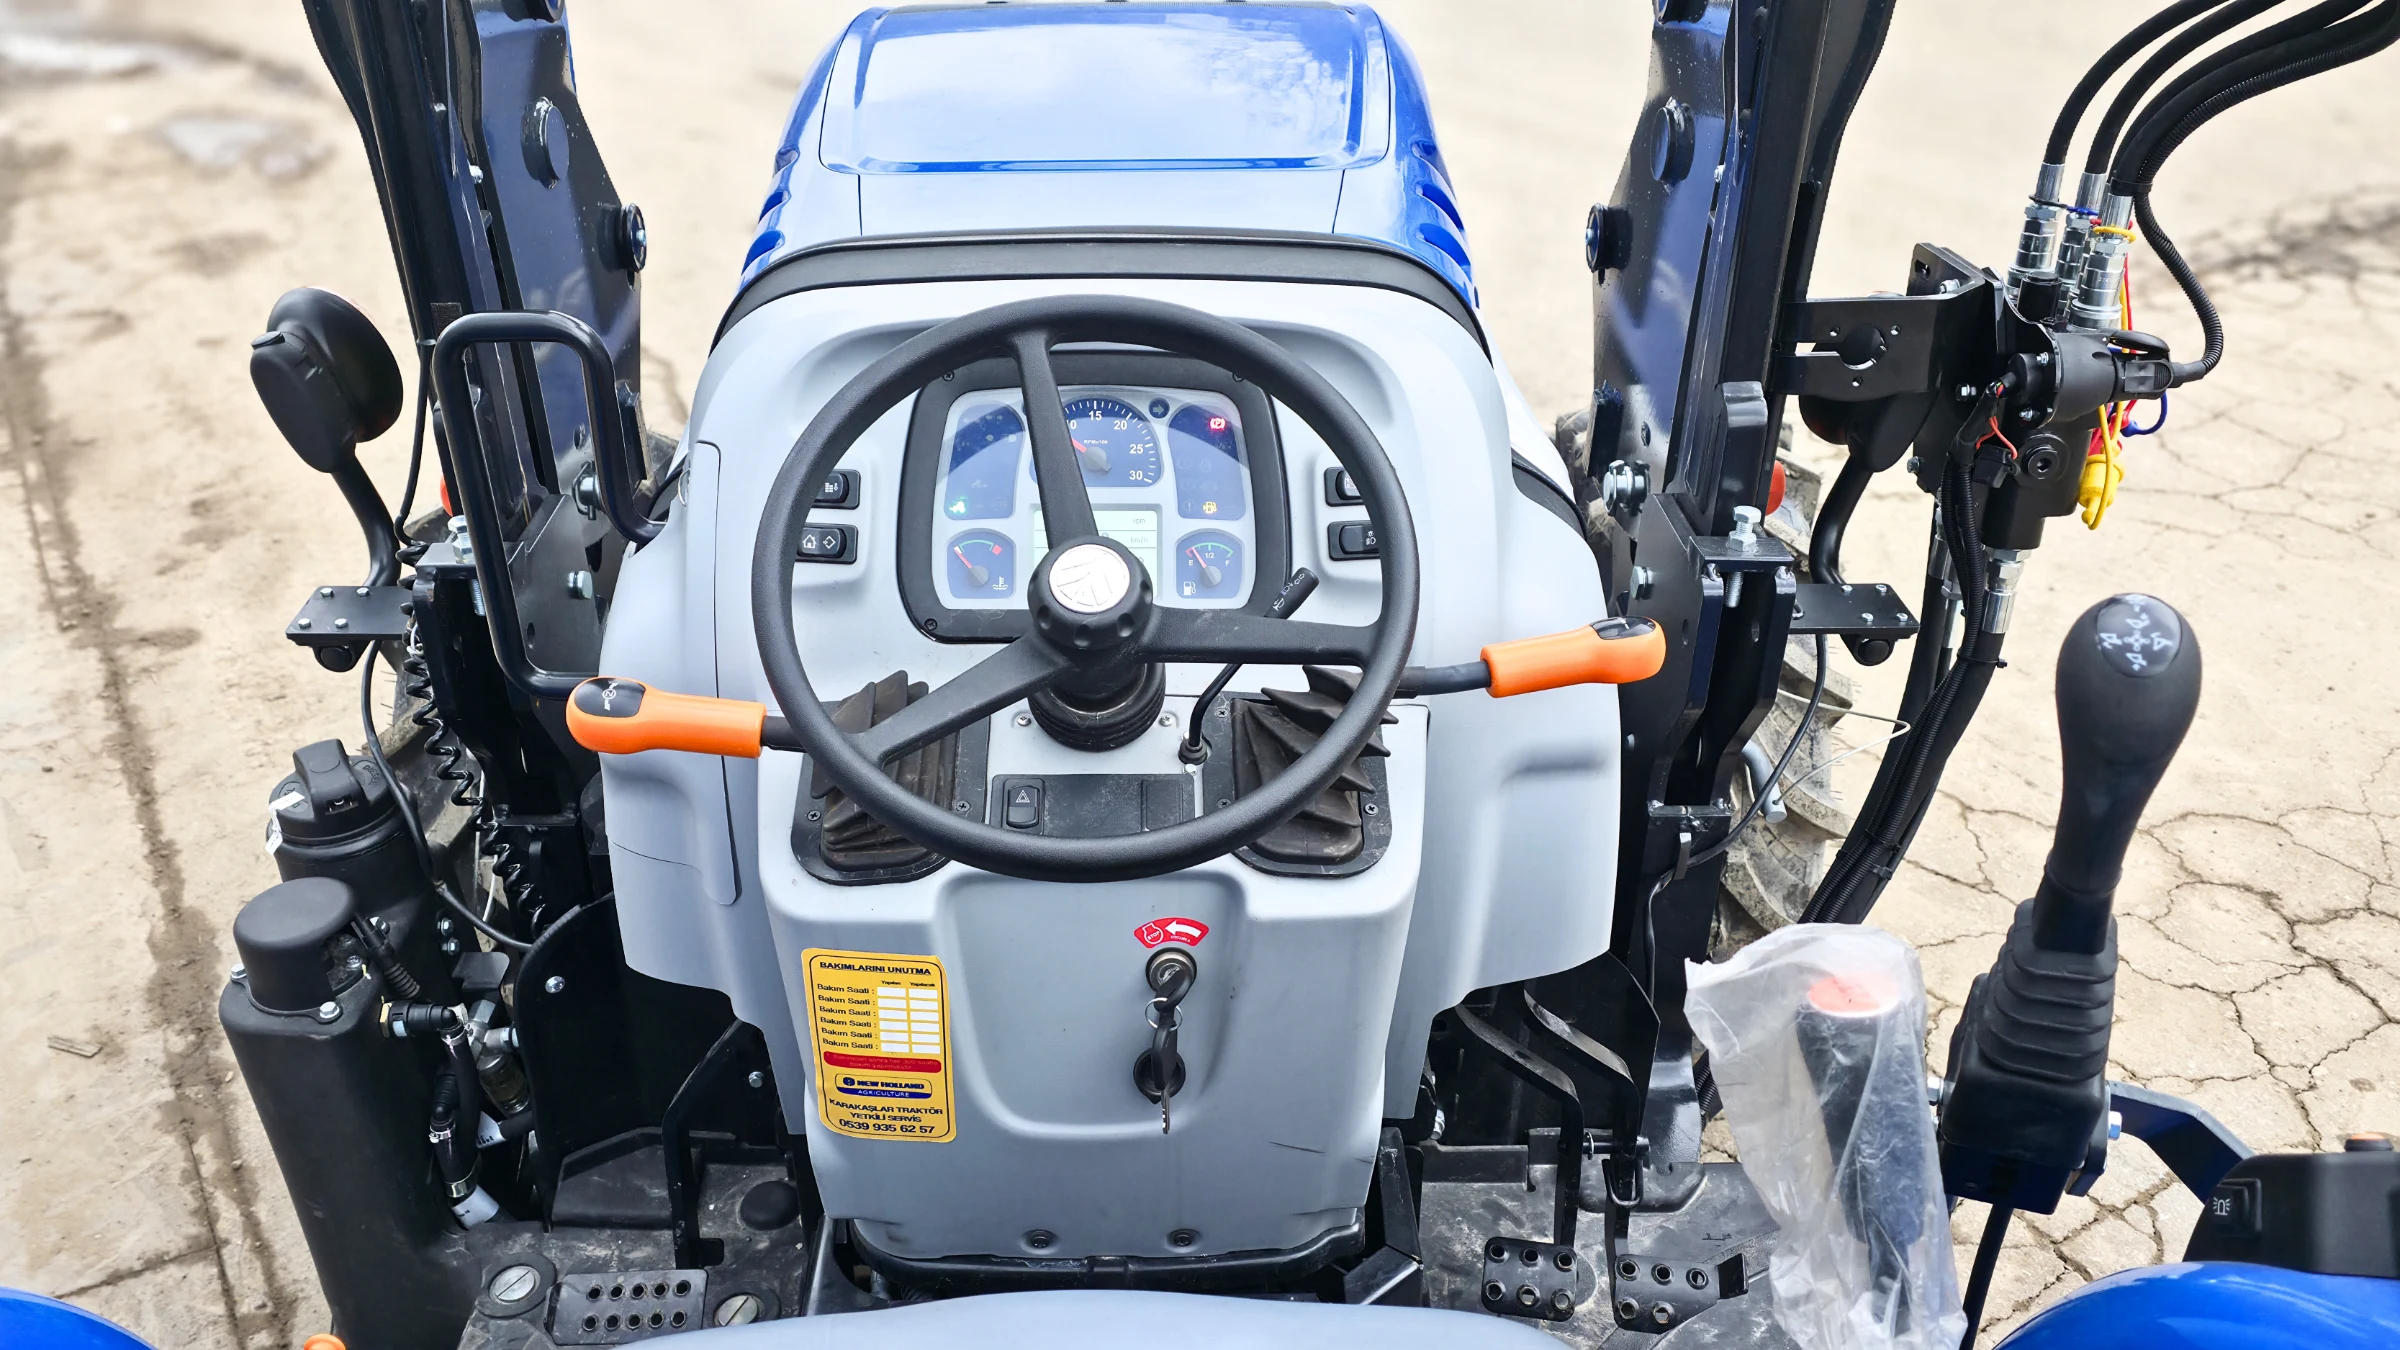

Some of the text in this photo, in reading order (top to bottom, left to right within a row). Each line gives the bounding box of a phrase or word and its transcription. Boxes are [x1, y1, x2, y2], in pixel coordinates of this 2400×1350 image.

[1088, 411, 1102, 421] 15
[1114, 420, 1127, 430] 20
[1129, 444, 1143, 454] 25
[1129, 470, 1143, 480] 30
[1147, 931, 1160, 940] STOP
[820, 961, 931, 975] BAKIMLARINI UNUTMA
[817, 984, 844, 993] Bakım
[818, 995, 845, 1004] Bakım
[819, 1006, 846, 1015] Bakım
[820, 1017, 847, 1026] Bakım
[821, 1027, 848, 1037] Bakım
[823, 1038, 849, 1048] Bakım
[881, 1081, 924, 1089] HOLLAND
[858, 1090, 910, 1098] AGRICULTURE
[829, 1098, 894, 1113] KARAKAŞLAR
[850, 1112, 921, 1122] YETKİLİ SERVİS
[839, 1118, 935, 1134] 0539 935 62 57
